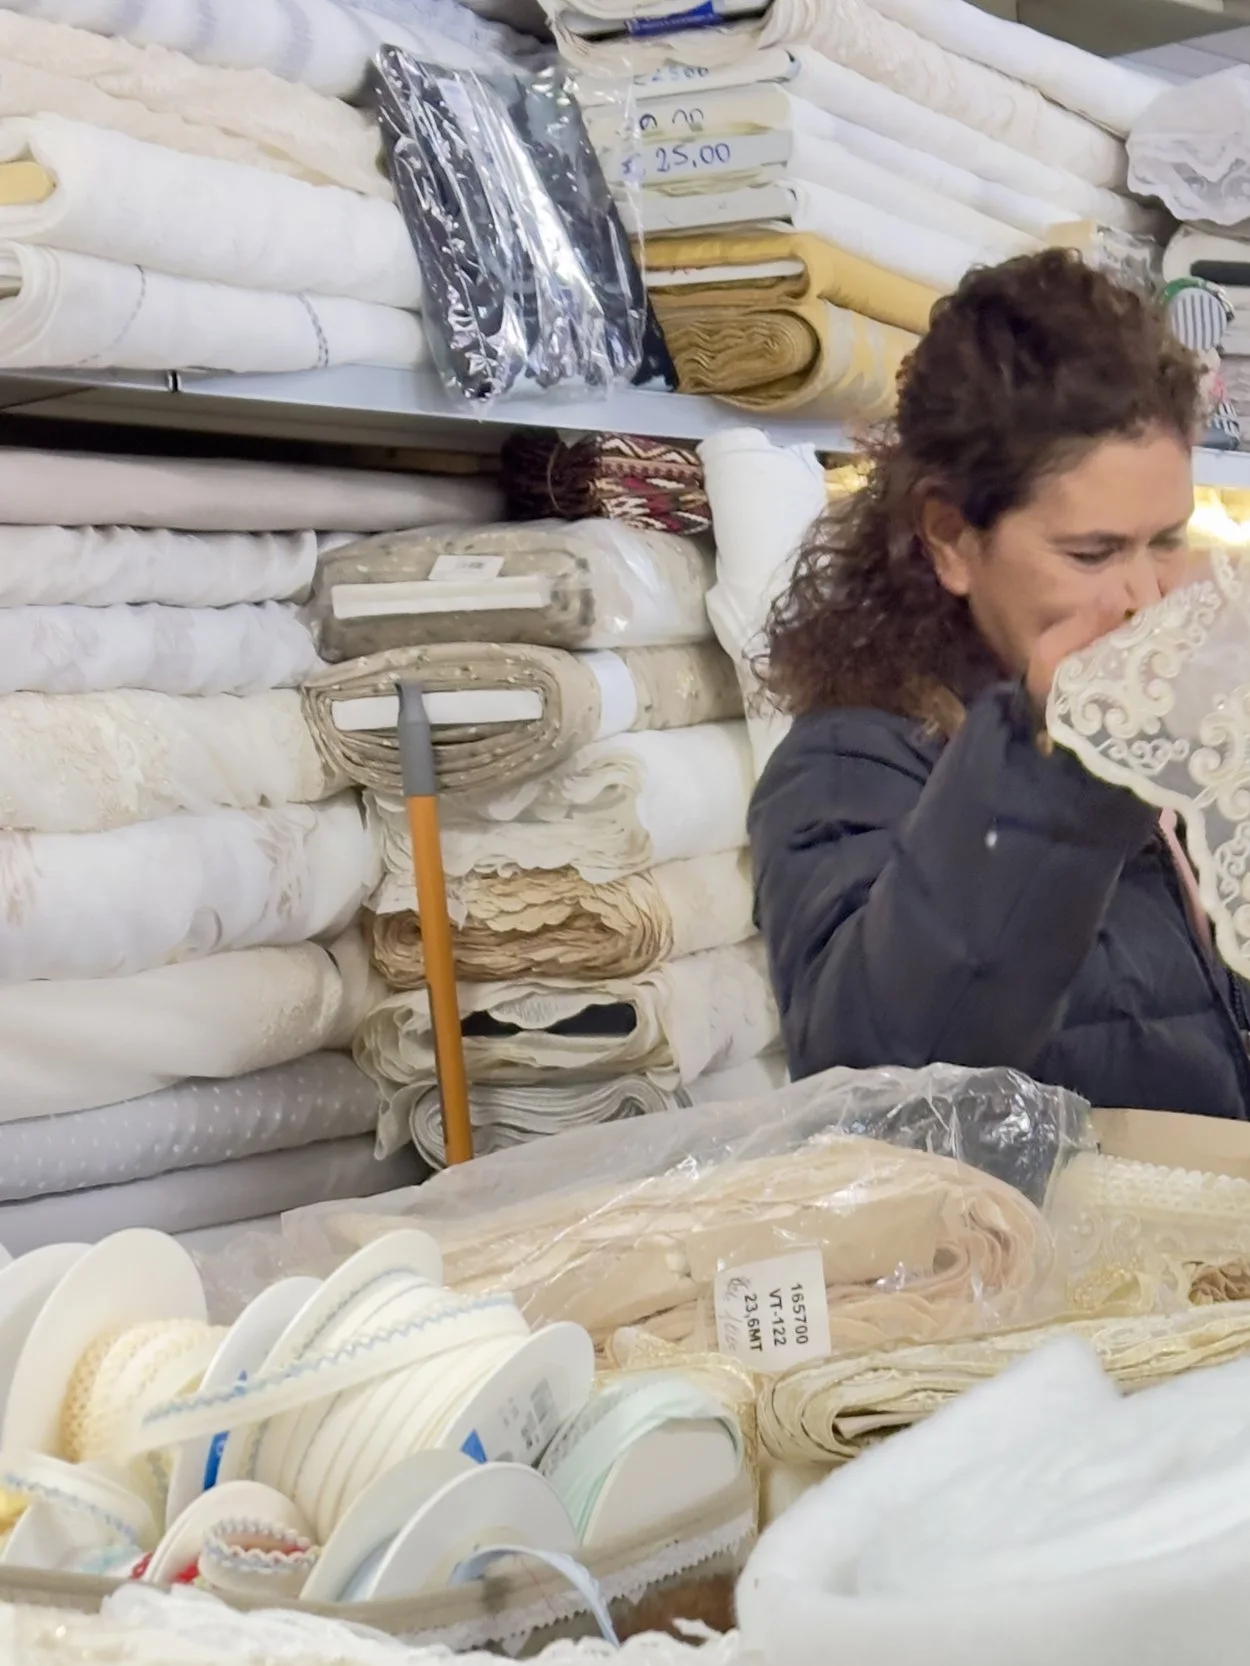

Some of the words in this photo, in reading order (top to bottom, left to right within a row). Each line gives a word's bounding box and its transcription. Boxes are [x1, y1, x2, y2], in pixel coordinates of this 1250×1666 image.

[744, 1293, 763, 1352] 23,6MT
[769, 1288, 787, 1347] VT-122
[790, 1281, 809, 1345] 165700
